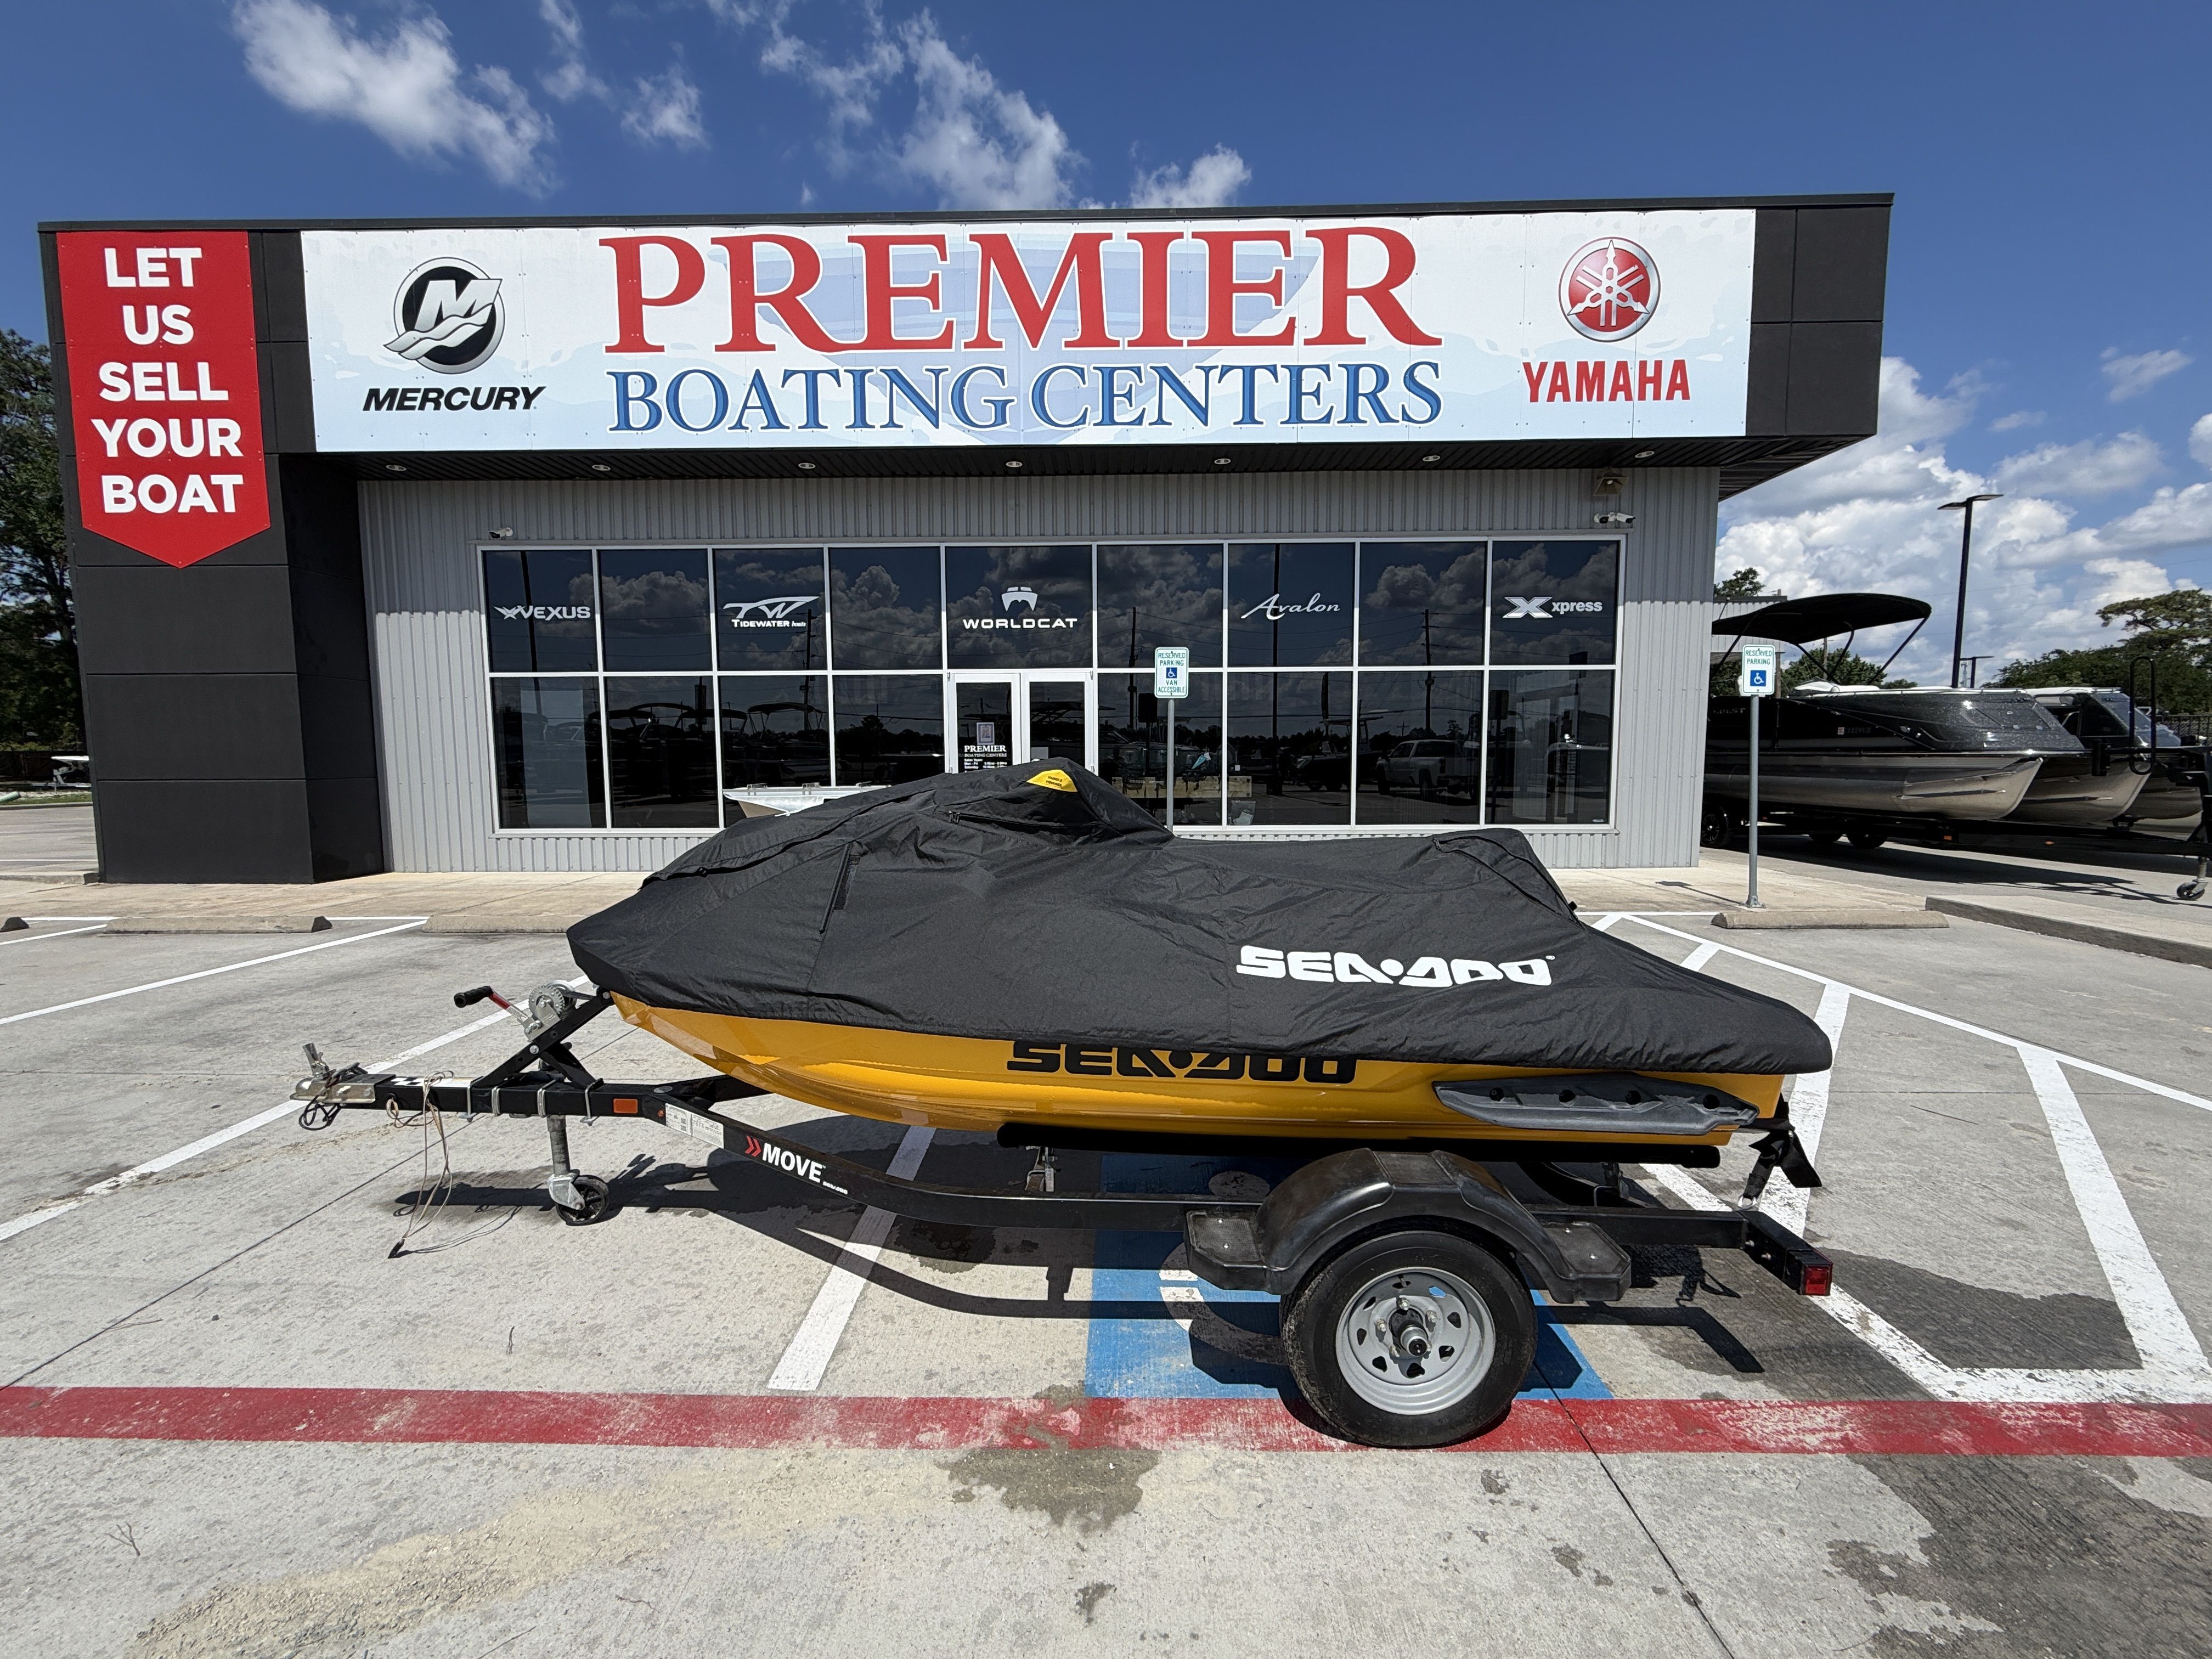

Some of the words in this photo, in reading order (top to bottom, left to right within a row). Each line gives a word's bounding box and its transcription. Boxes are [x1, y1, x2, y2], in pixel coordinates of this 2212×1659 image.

[104, 247, 202, 289] LET
[599, 227, 1442, 352] PREMIER
[122, 304, 194, 346] US
[98, 361, 229, 402] SELL
[363, 387, 547, 411] MERCURY
[606, 365, 1015, 432] BOATING
[1031, 360, 1442, 429] CENTERS
[1522, 359, 1690, 403] YAMAHA
[91, 417, 244, 458] YOUR
[101, 473, 244, 514] BOAT
[517, 605, 591, 621] VEXUS
[963, 618, 1078, 629] WORLDCAT
[1240, 592, 1341, 620] Avalon
[763, 1142, 823, 1183] MOVE
